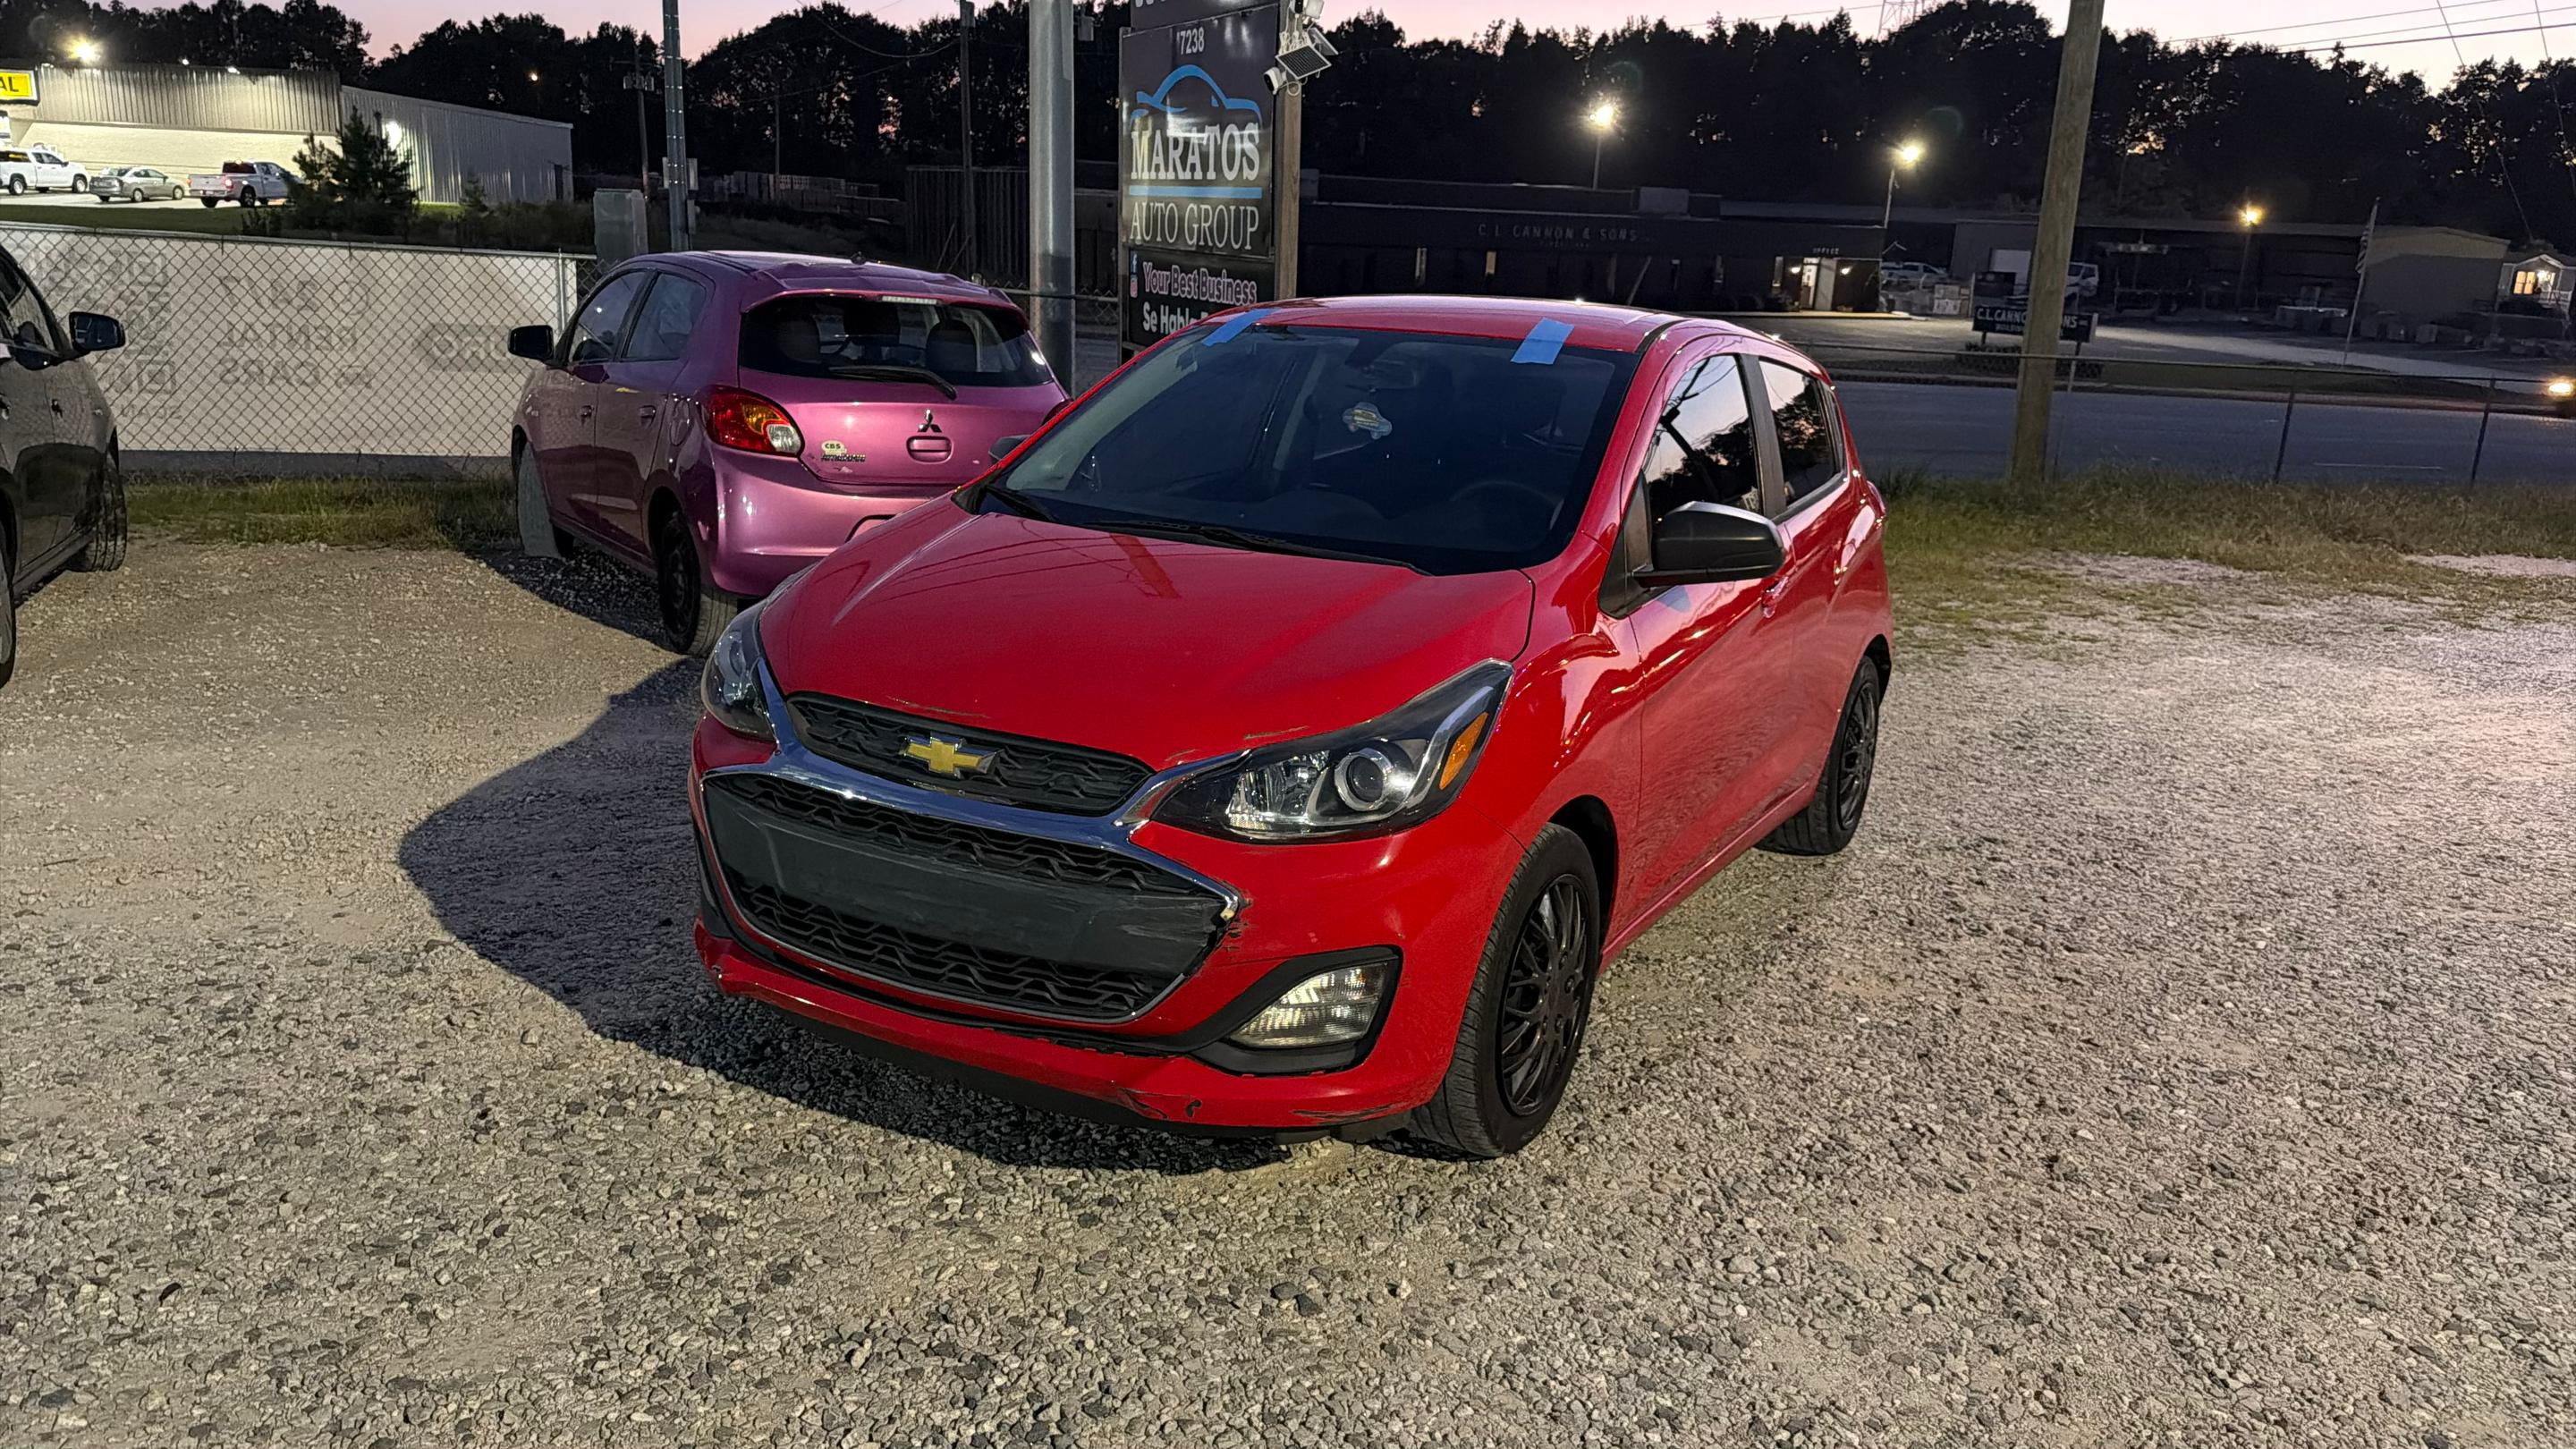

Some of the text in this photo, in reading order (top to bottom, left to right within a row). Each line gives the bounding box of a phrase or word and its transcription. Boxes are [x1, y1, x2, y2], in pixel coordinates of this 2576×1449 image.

[1131, 123, 1260, 181] MARATOS
[1130, 201, 1259, 250] AUTO GROUP
[1513, 225, 1574, 240] CANNON
[1599, 228, 1638, 242] SONS
[1142, 261, 1258, 306] Your Best Business
[1142, 301, 1197, 335] Se Habl
